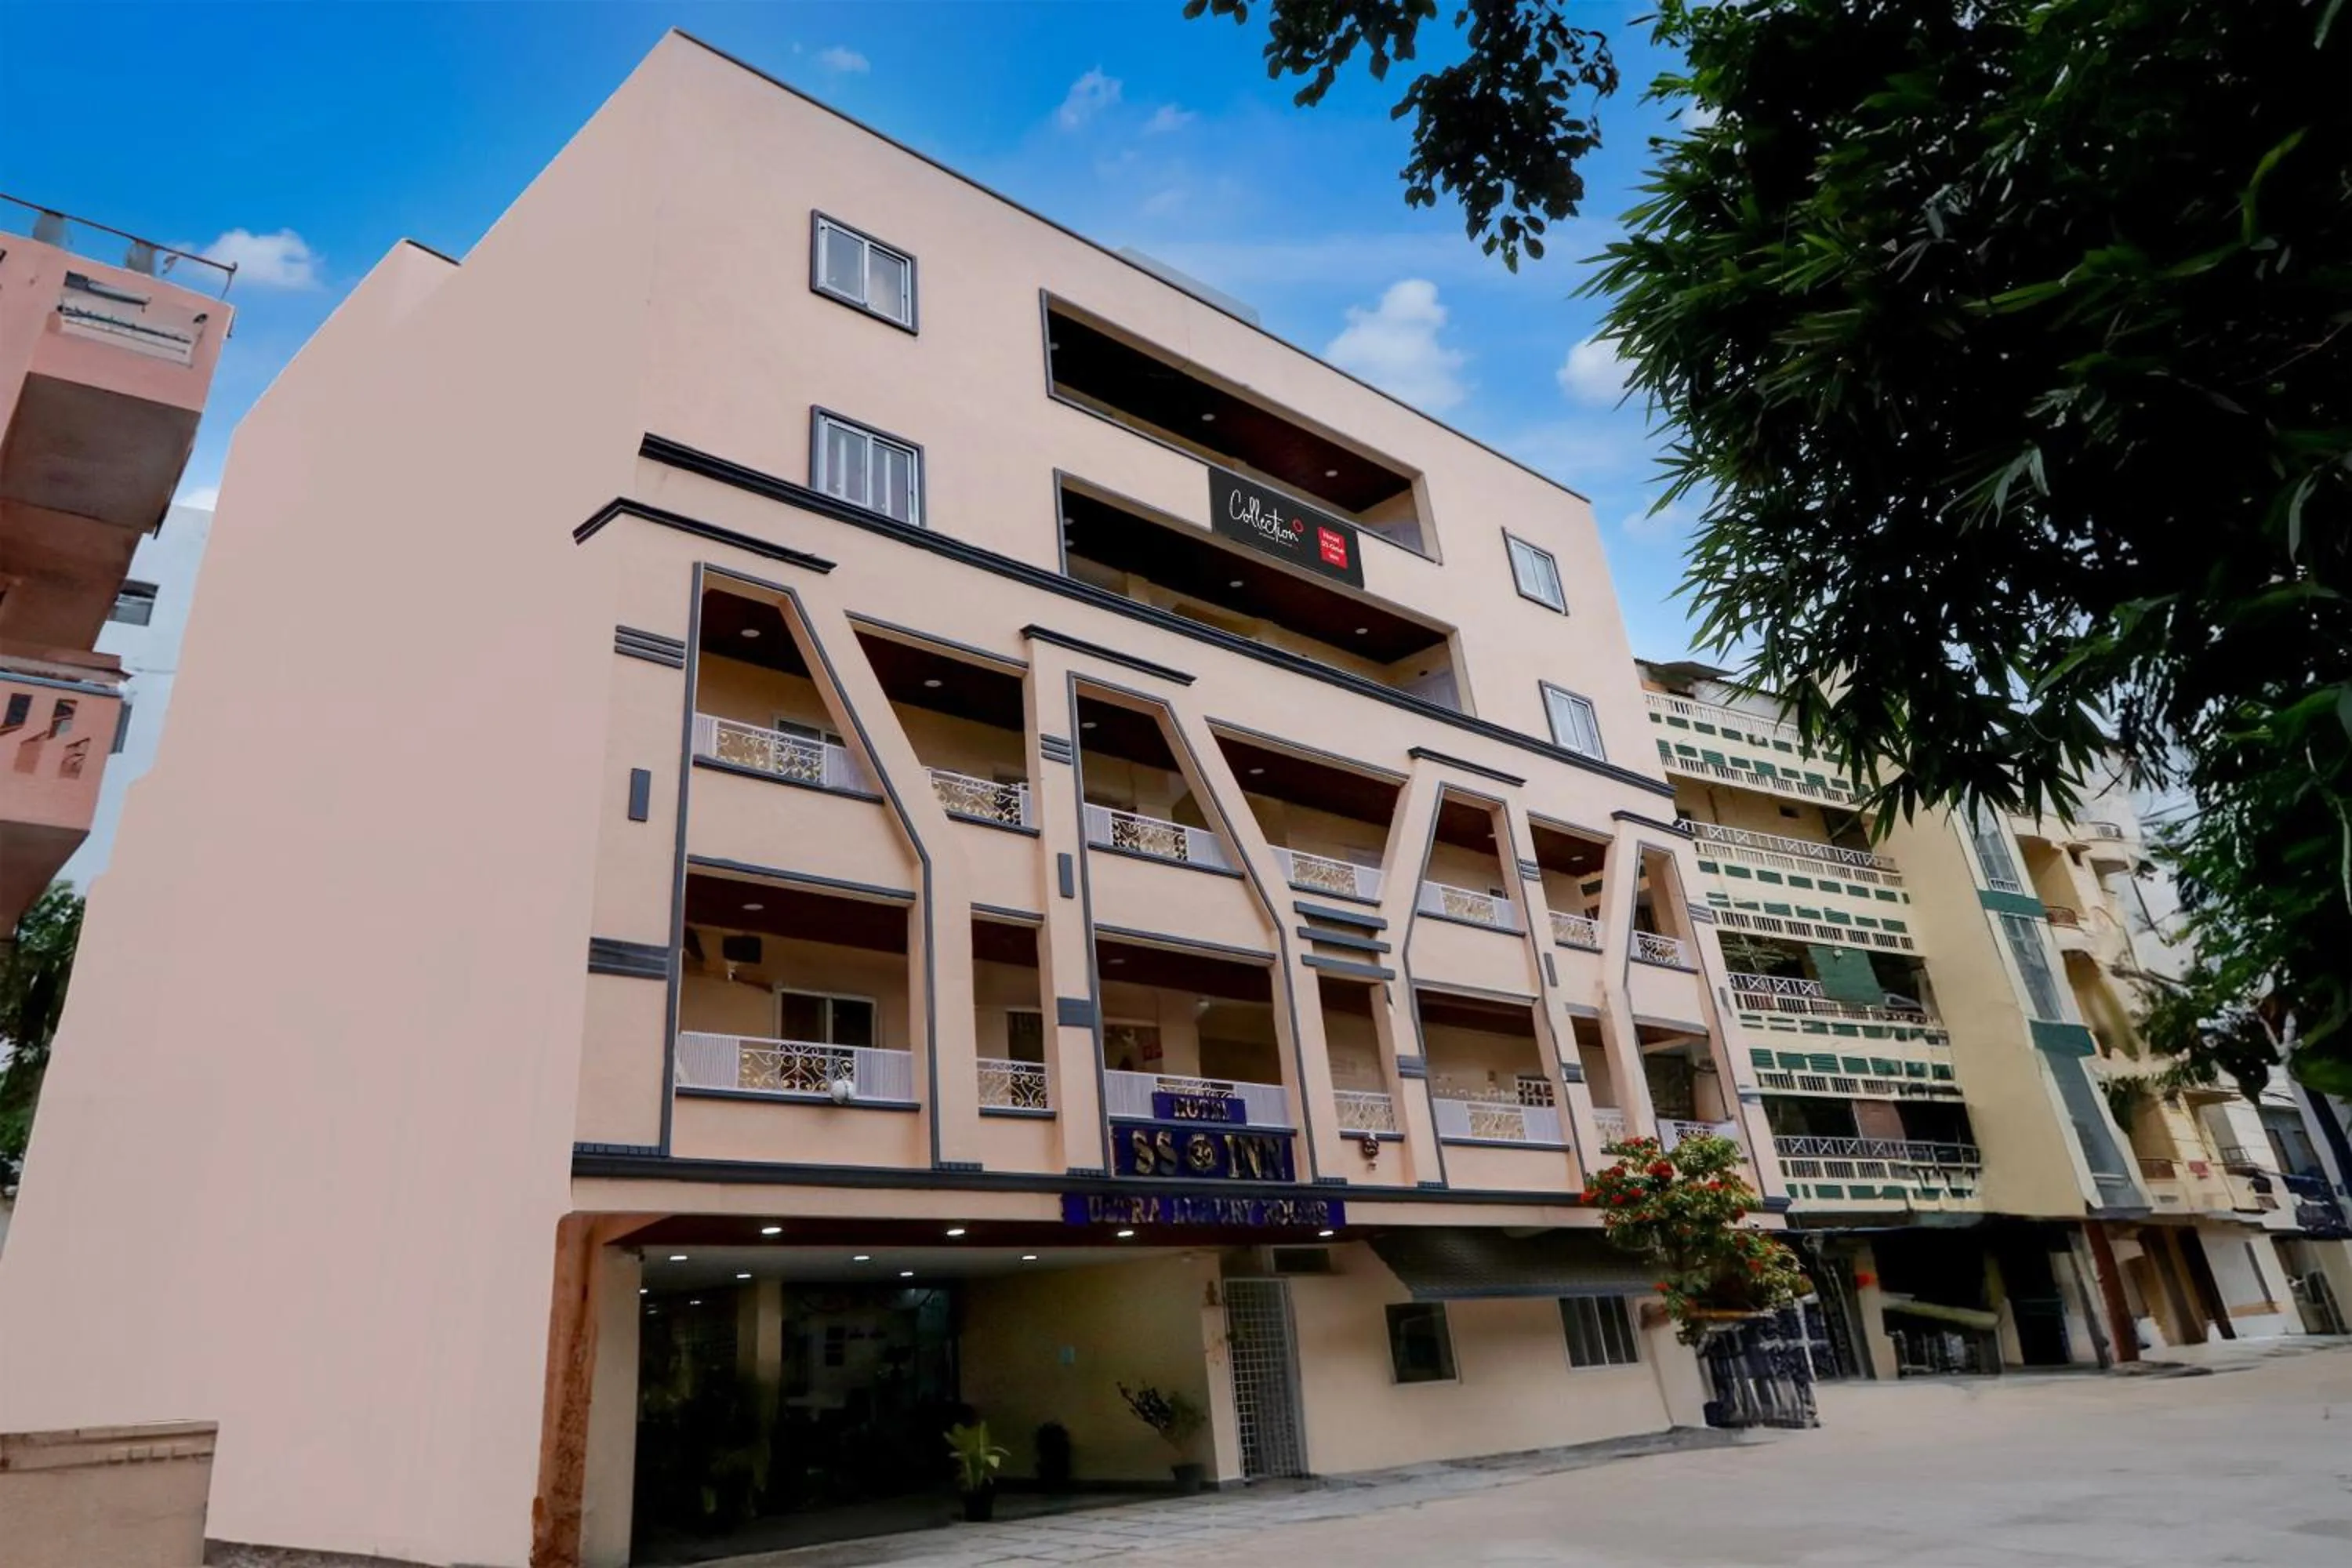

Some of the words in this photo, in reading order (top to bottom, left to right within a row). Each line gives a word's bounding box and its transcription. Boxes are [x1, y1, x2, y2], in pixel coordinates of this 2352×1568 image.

[1229, 489, 1298, 543] Collection
[1173, 1097, 1230, 1120] HOTEL
[1131, 1129, 1178, 1175] SS
[1223, 1134, 1287, 1179] INN
[1087, 1196, 1163, 1224] ULTRA
